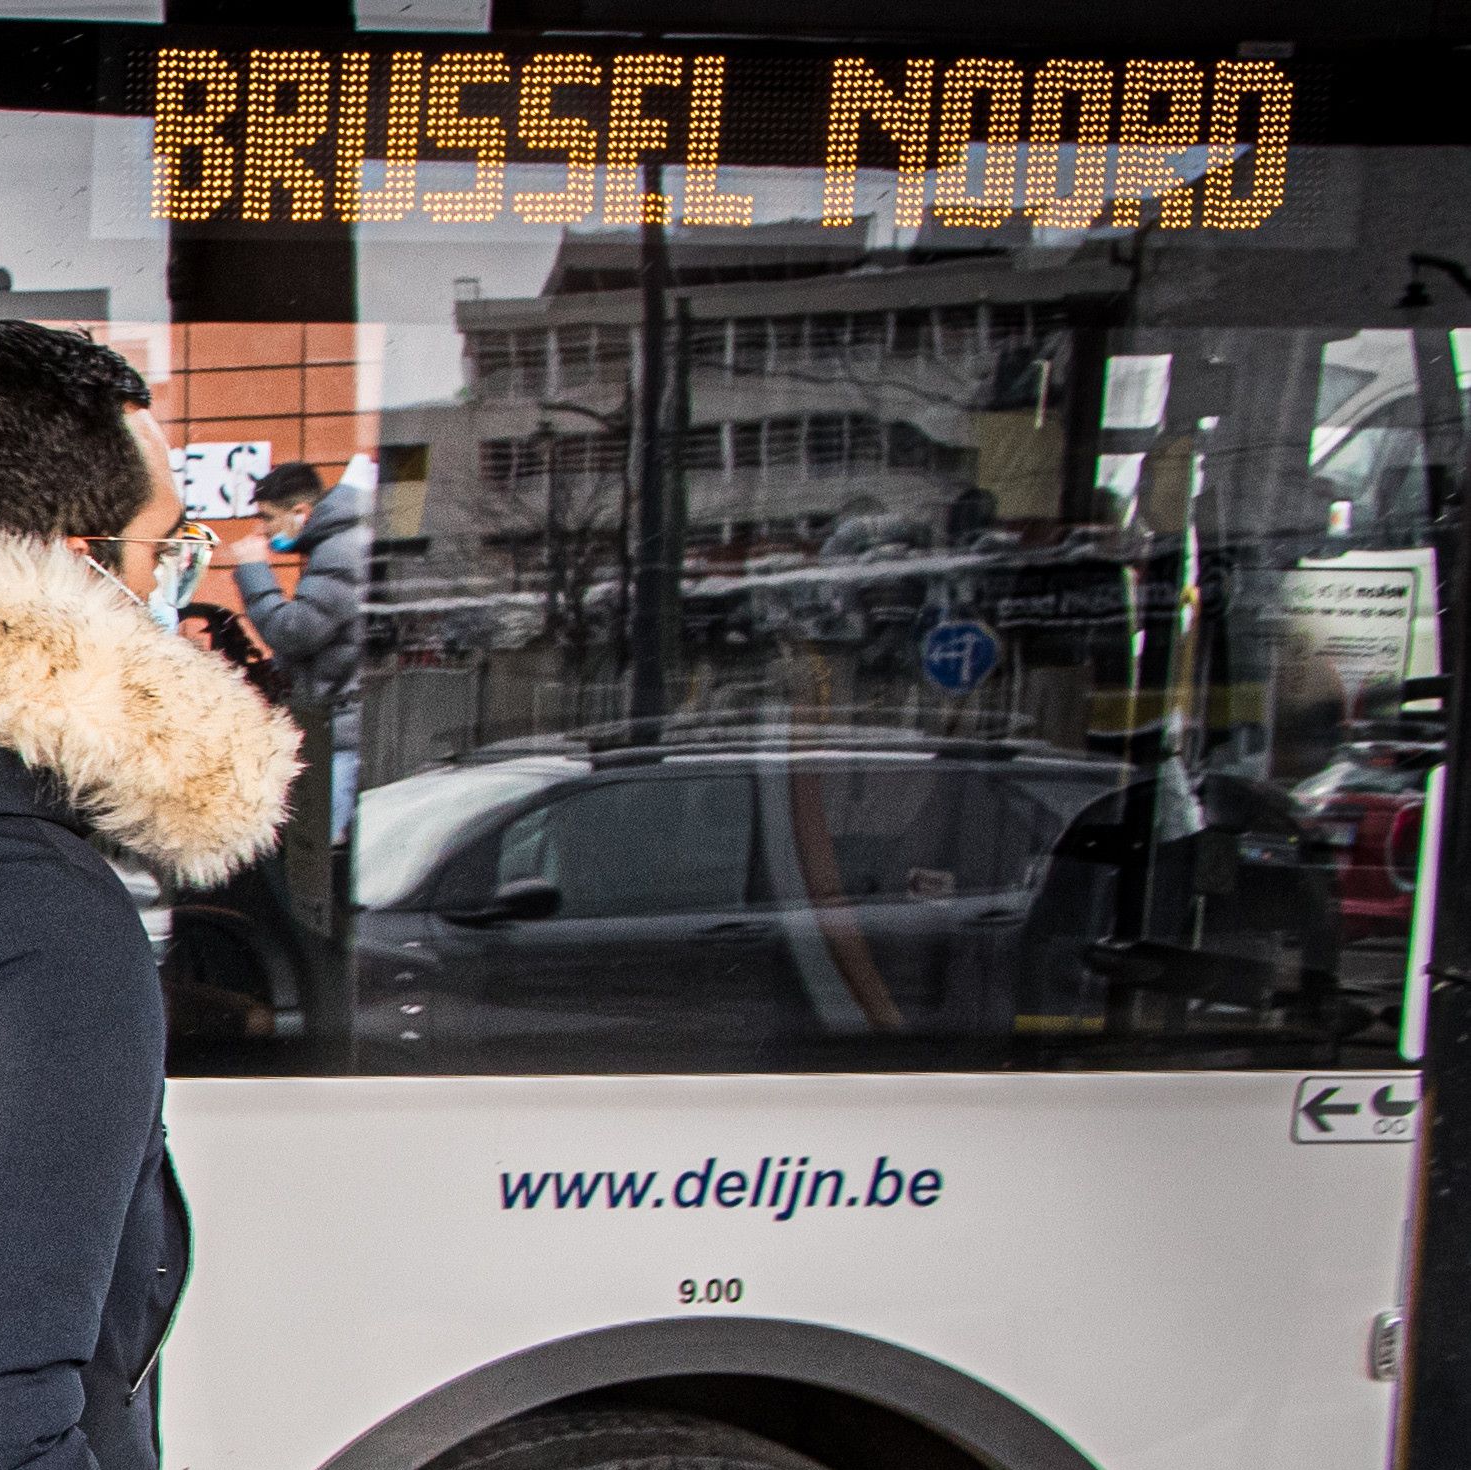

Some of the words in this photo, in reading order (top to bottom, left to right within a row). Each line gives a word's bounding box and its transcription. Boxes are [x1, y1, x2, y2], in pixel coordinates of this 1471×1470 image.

[150, 48, 754, 227] BRUSSEL
[821, 56, 1296, 232] NOORD
[499, 1156, 945, 1222] www.delijn.be
[678, 1277, 743, 1305] 9.00
